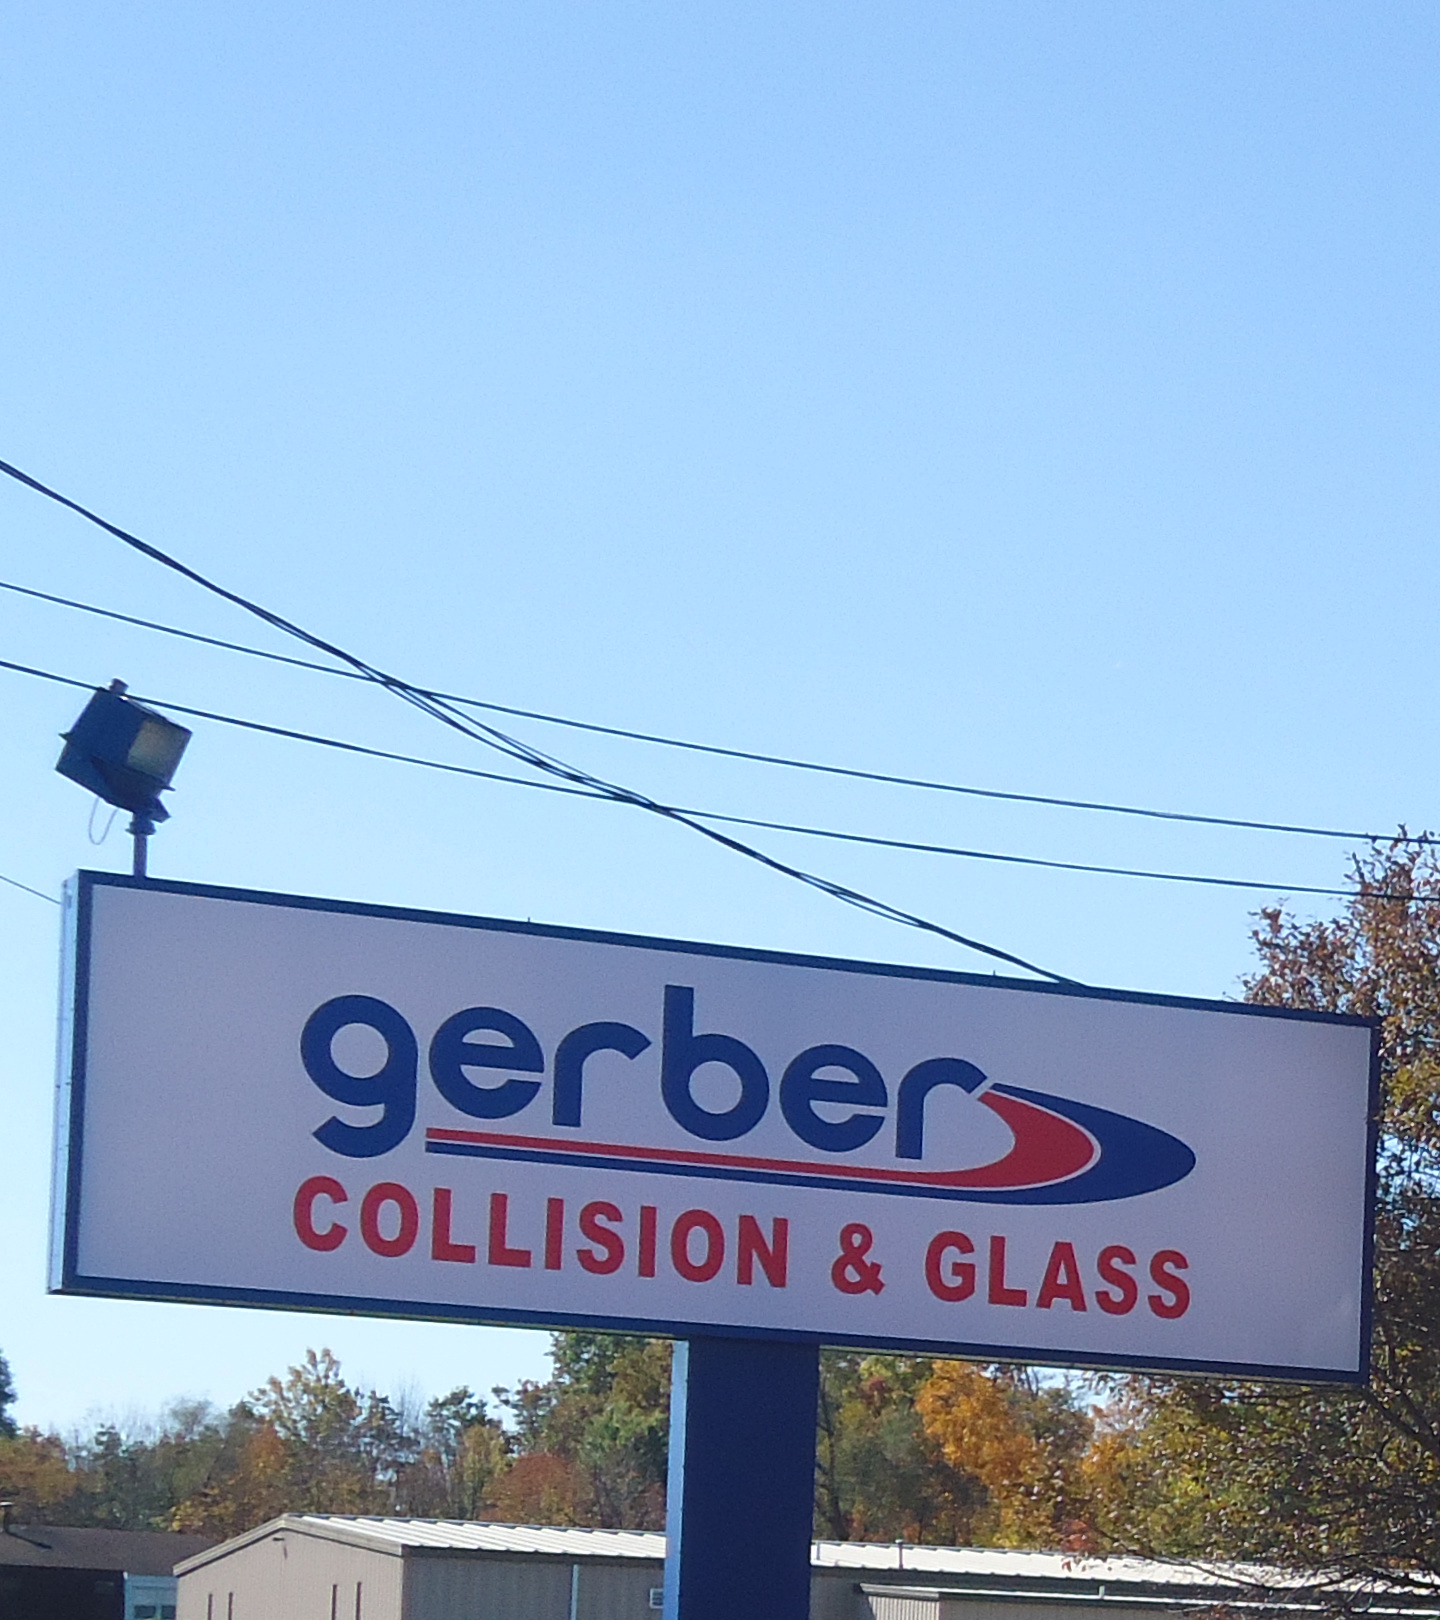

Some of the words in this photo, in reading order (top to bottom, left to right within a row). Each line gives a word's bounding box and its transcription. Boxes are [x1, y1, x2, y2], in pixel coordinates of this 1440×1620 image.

[299, 983, 987, 1160] gerber
[292, 1174, 790, 1290] COLLISION
[832, 1222, 885, 1297] &
[924, 1230, 1194, 1322] GLASS
